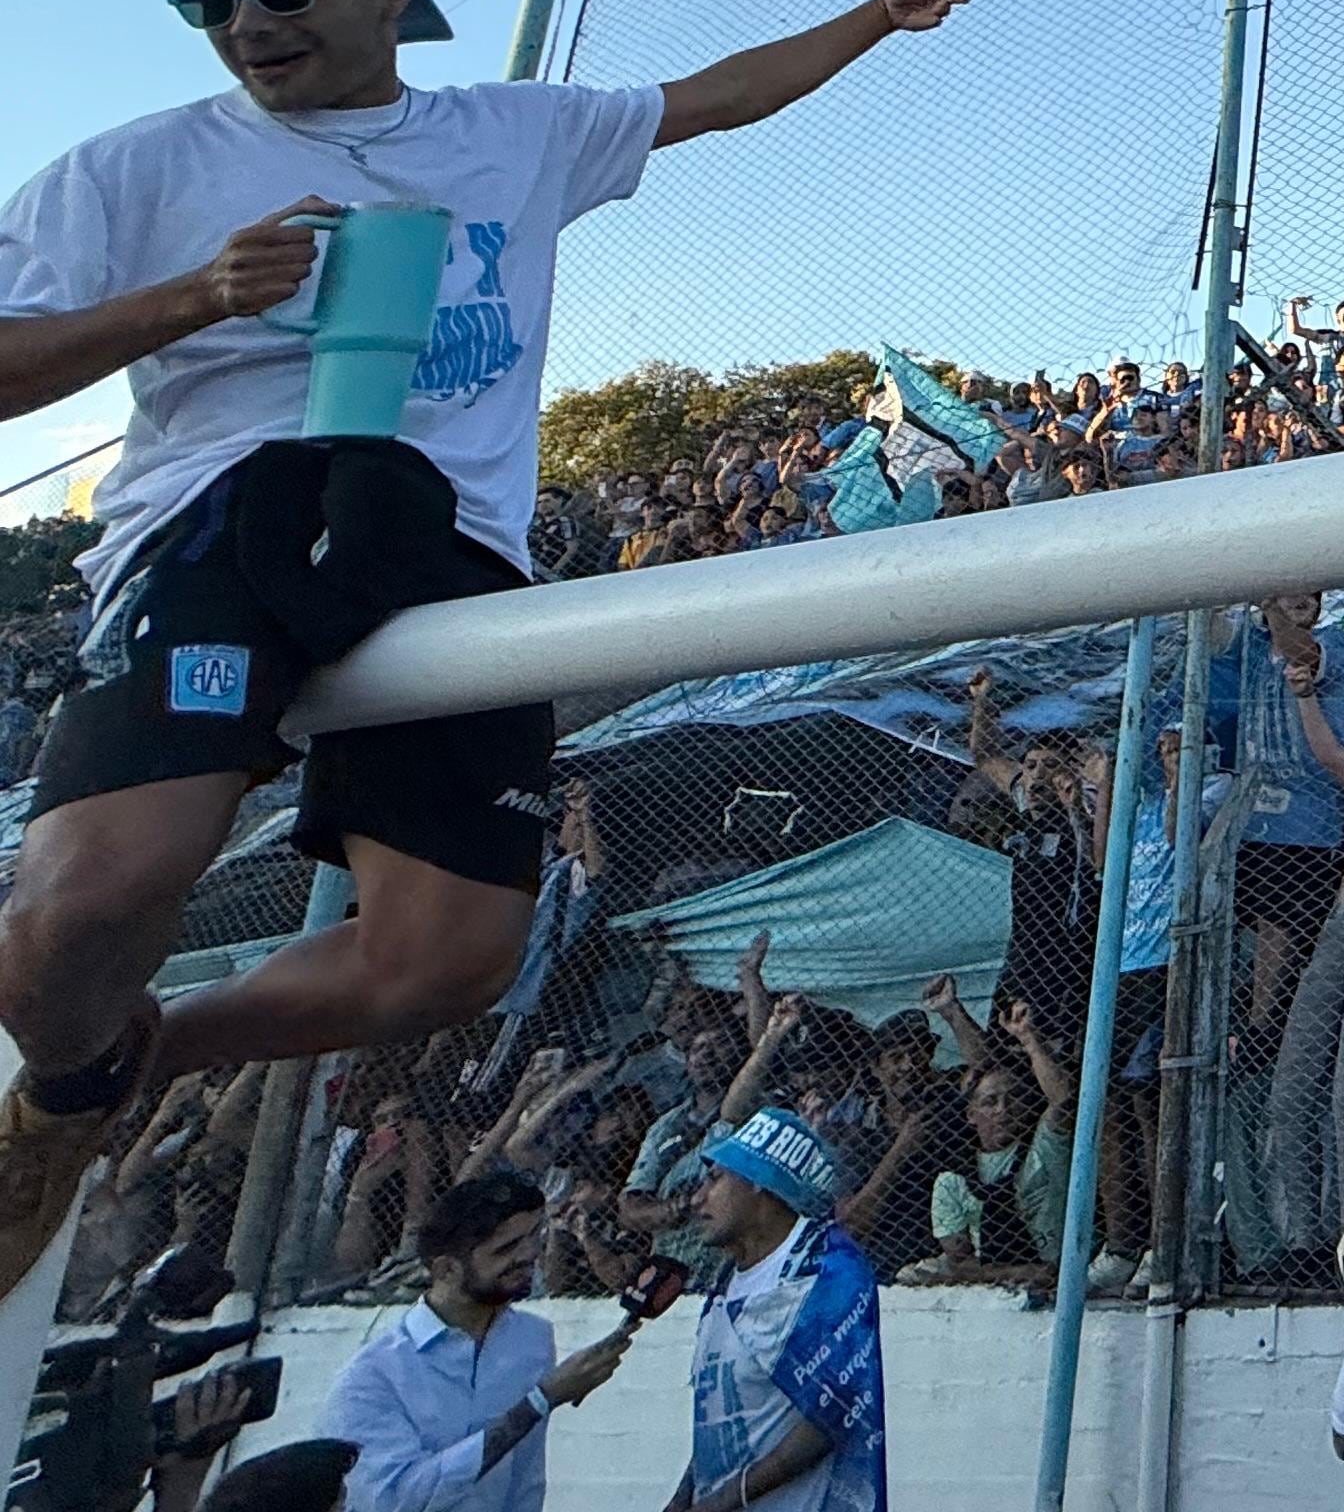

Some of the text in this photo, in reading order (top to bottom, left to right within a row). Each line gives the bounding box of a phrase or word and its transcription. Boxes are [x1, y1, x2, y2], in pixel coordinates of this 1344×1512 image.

[766, 1124, 814, 1170] RIO
[792, 1288, 874, 1387] Para much
[838, 1339, 875, 1386] arqu
